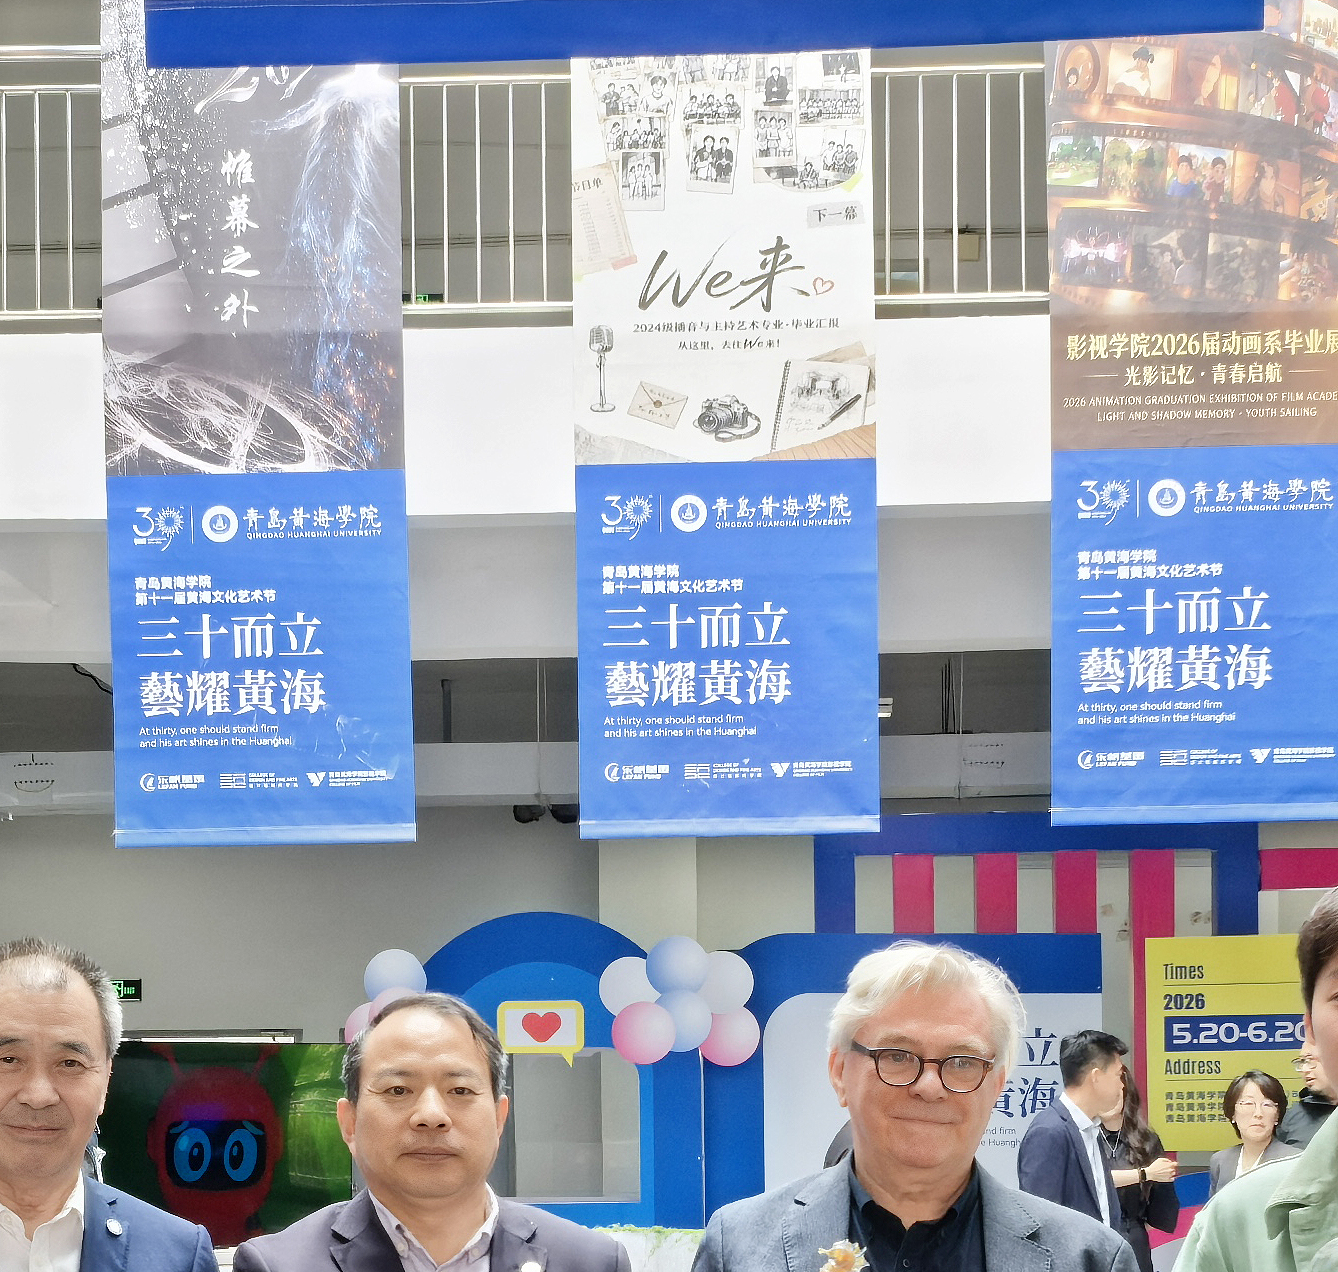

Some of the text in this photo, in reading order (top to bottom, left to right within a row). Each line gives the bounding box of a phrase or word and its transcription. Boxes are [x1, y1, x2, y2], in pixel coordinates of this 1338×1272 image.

[220, 148, 260, 329] 帷幕之外
[1063, 397, 1086, 408] 2026
[1089, 395, 1142, 407] ANIMATION
[1144, 393, 1205, 405] GRADUATION
[1209, 393, 1263, 403] EXHIBITION
[1266, 392, 1278, 402] OF
[1281, 392, 1303, 402] FILM
[1097, 407, 1317, 422] LIGHT AND SHADOW MEMORY YOUTH SAILING
[1236, 504, 1280, 512] HUANGHAI
[1283, 502, 1334, 511] UNIVERSITY
[802, 518, 852, 527] UNIVERSITY
[1077, 586, 1272, 635] 三十而立
[603, 601, 791, 650] 三十而立
[136, 612, 324, 660] 三十而立
[1077, 702, 1089, 712] At
[1091, 703, 1117, 714] thirty,
[1140, 701, 1173, 710] should
[1174, 700, 1201, 709] stand
[1202, 700, 1224, 713] firm
[1078, 712, 1236, 724] and his art shines in the Huanghai
[1163, 963, 1204, 980] Times
[1163, 993, 1205, 1011] 2026
[1017, 1028, 1059, 1066] 立
[1165, 1059, 1221, 1075] Address
